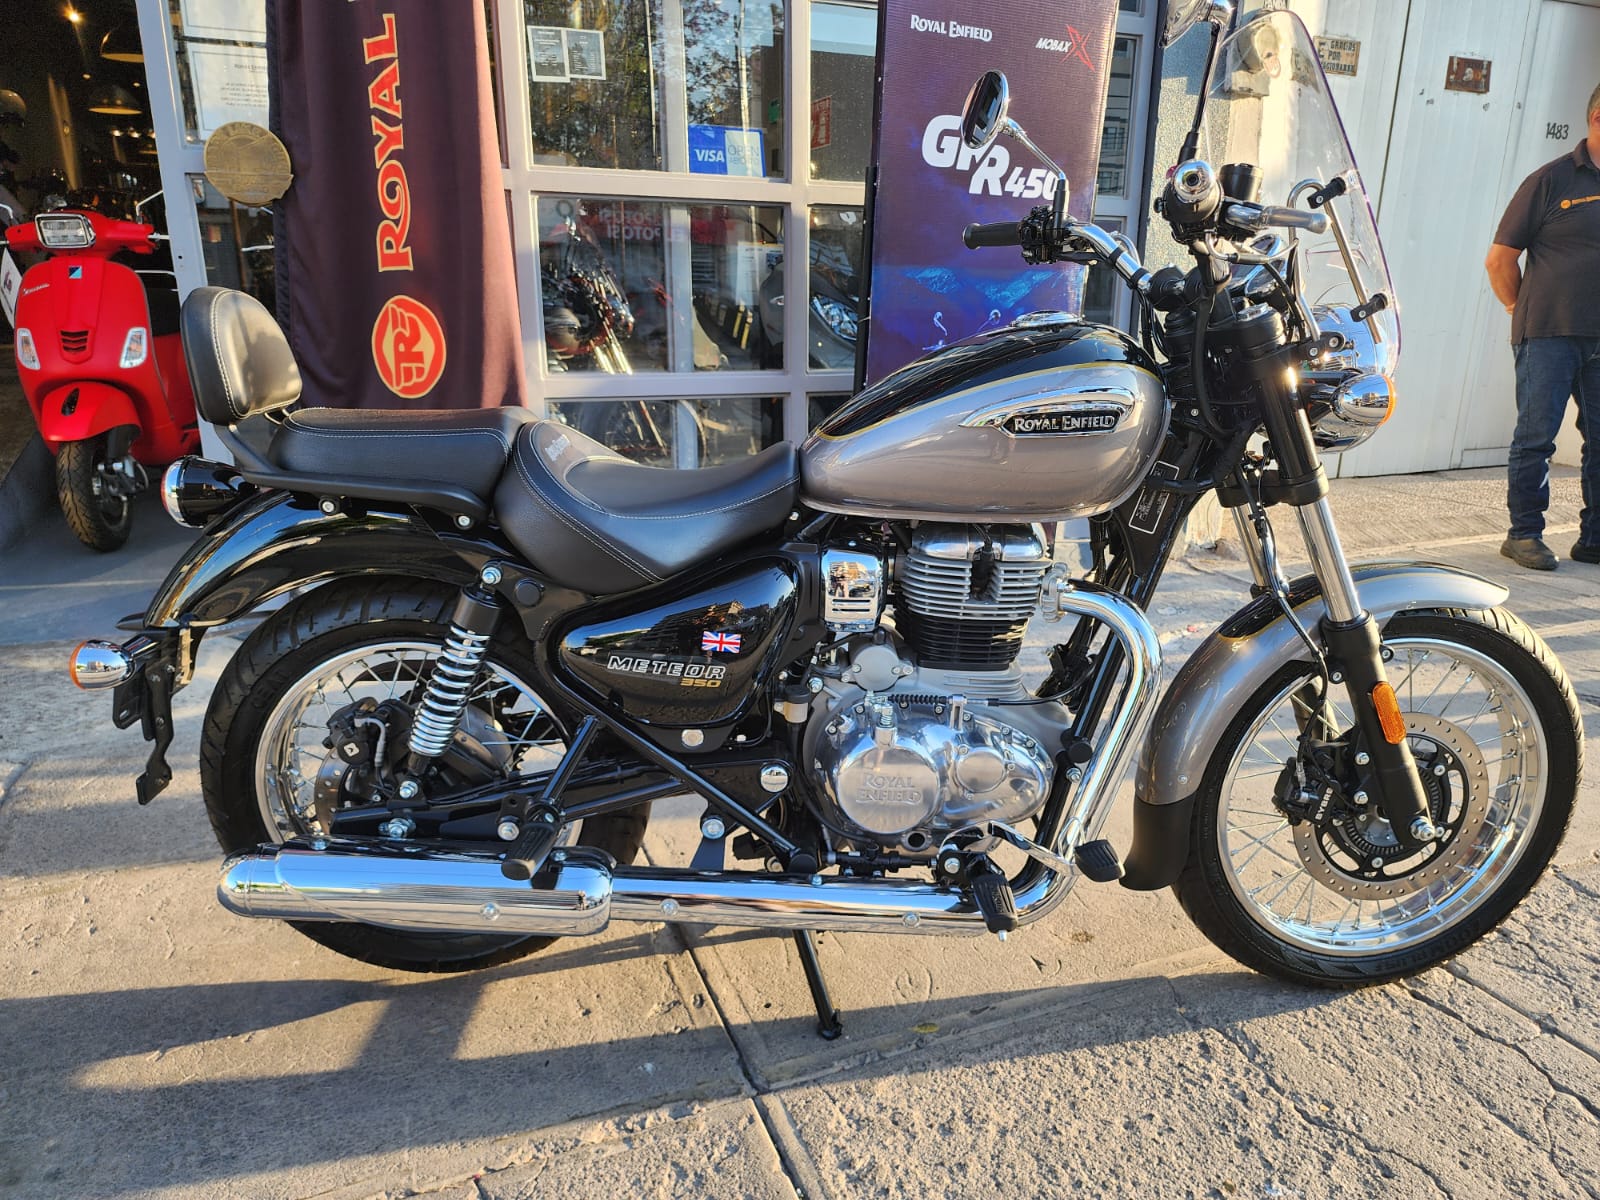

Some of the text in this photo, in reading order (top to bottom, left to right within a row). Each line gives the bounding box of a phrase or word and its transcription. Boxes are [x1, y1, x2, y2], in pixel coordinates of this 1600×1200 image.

[910, 14, 993, 42] ROYAL ENFIELD
[1546, 122, 1569, 140] 1483
[363, 13, 413, 272] ROYAL
[695, 149, 725, 162] VISA
[1013, 415, 1115, 432] ROYAL ENFIELD
[607, 655, 726, 680] METEOR
[680, 677, 722, 689] 350
[862, 773, 915, 789] ROYAL
[855, 788, 922, 805] ENFIELD
